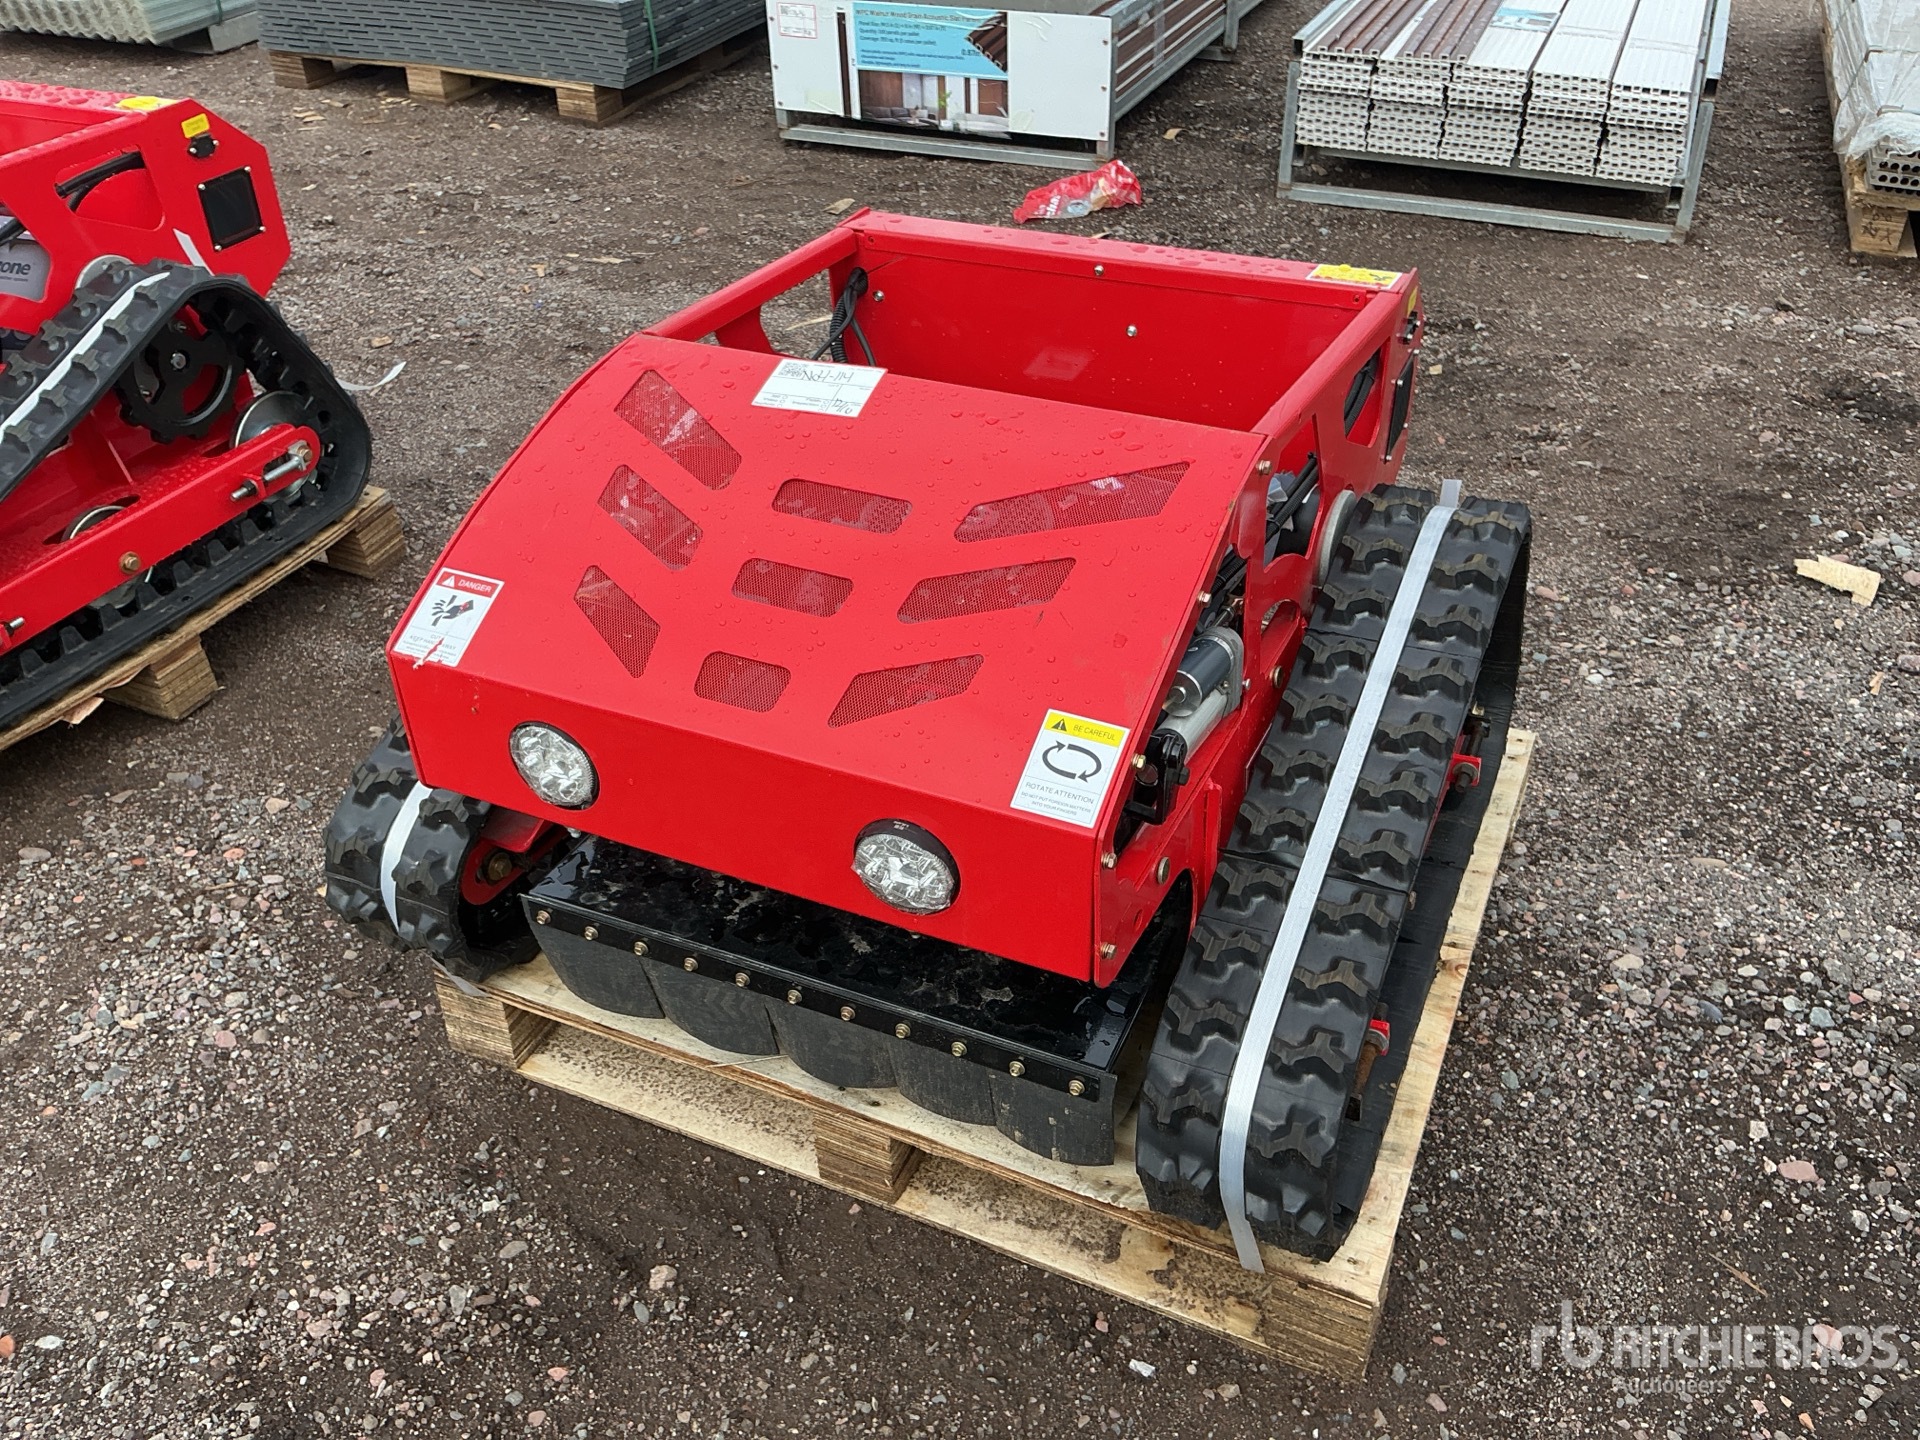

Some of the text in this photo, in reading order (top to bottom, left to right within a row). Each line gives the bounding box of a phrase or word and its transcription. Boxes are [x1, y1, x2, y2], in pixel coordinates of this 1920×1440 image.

[458, 578, 492, 593] DANGER
[1073, 724, 1116, 741] BE CAREFUL
[1025, 781, 1095, 804] ROTATE ATTENTION
